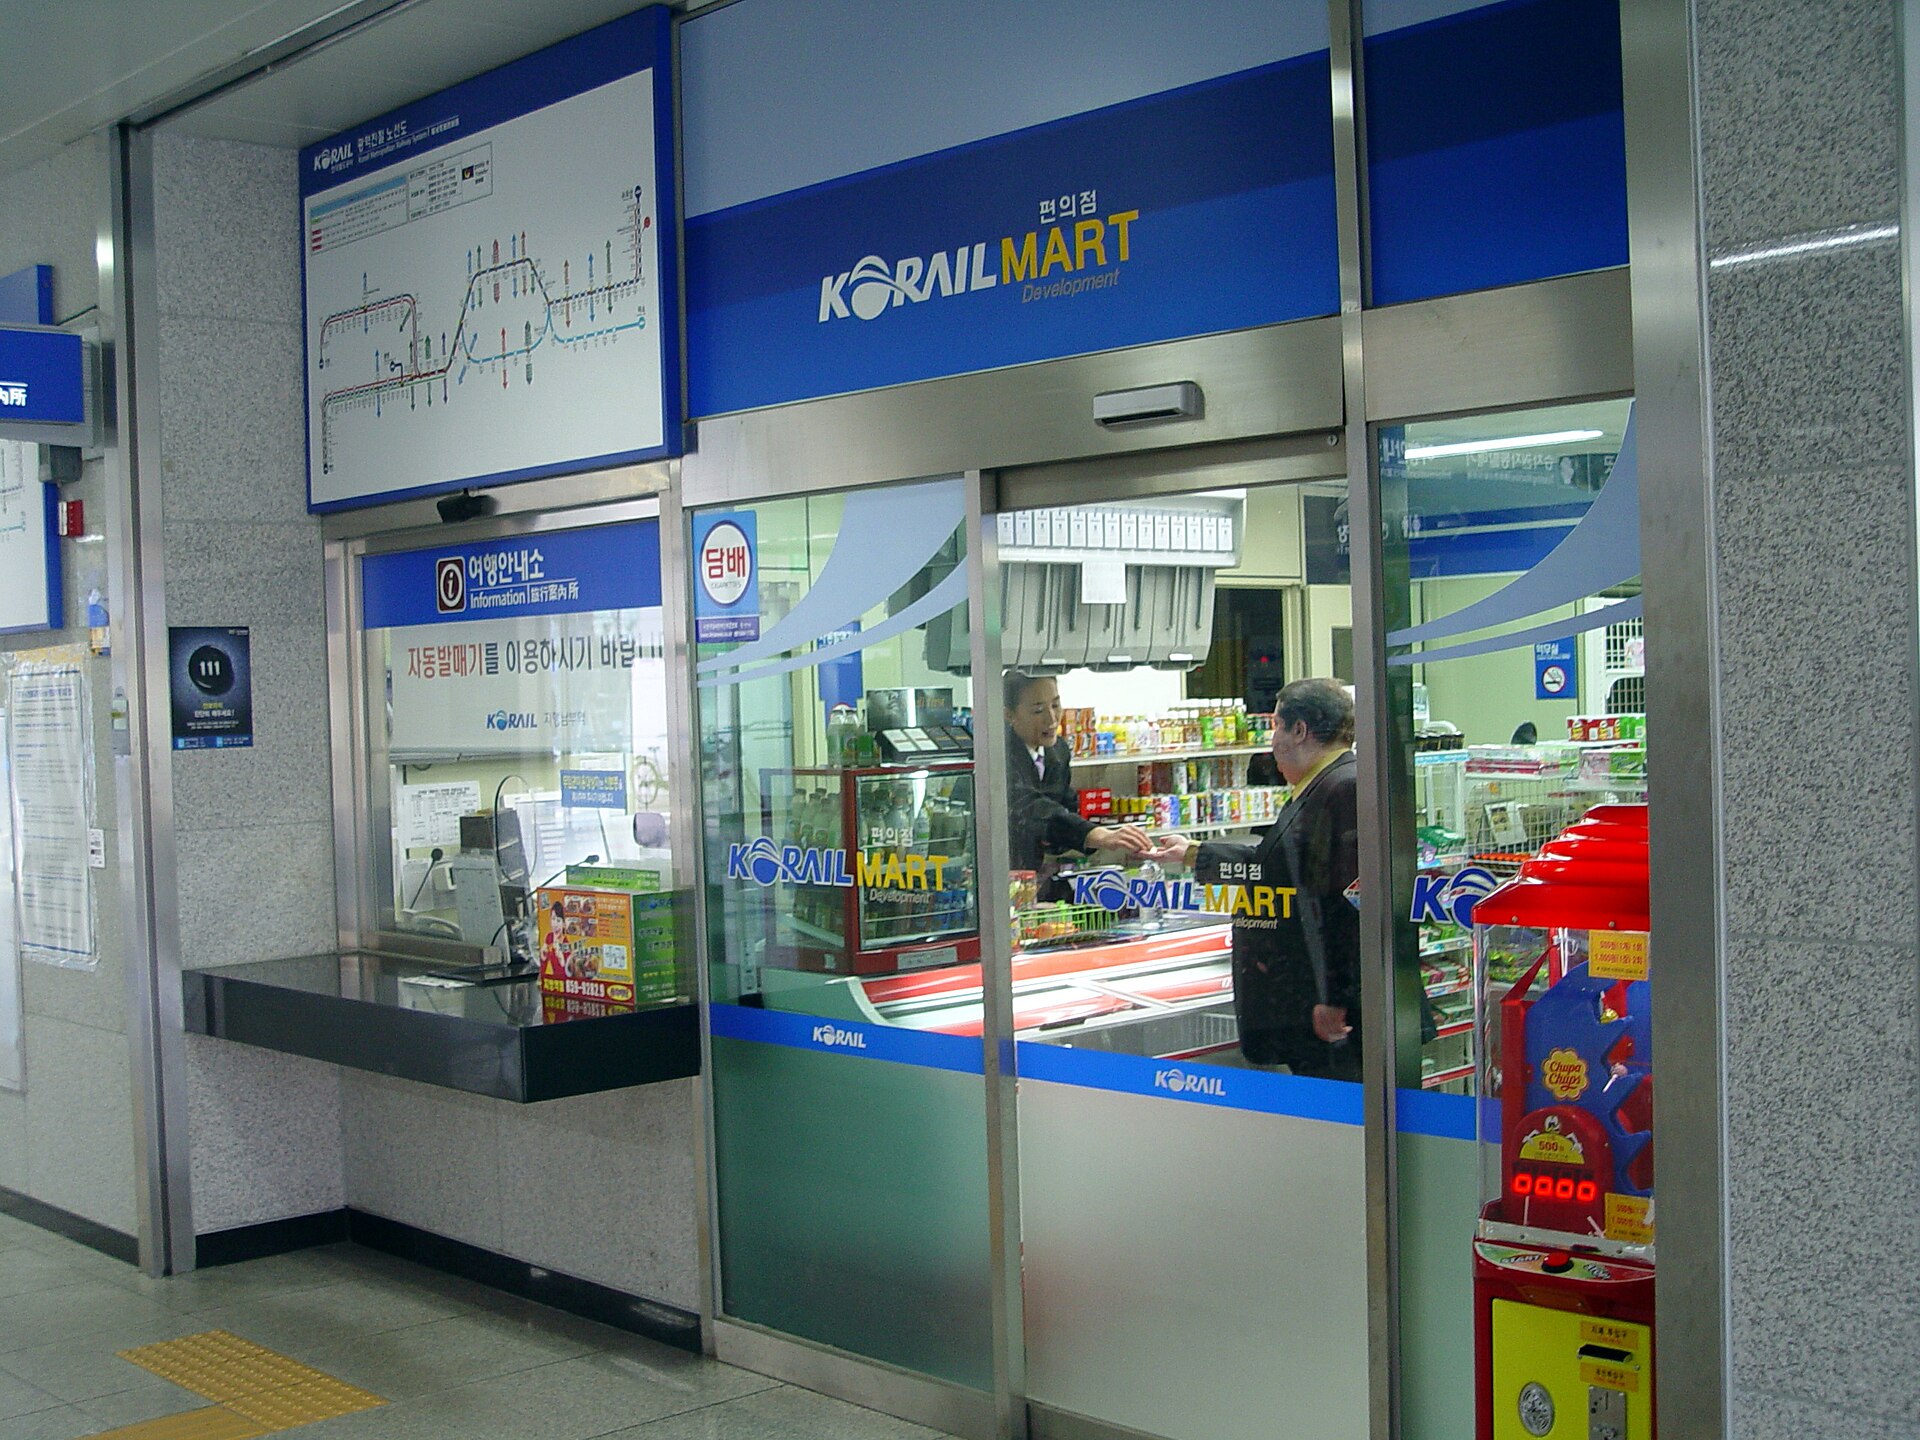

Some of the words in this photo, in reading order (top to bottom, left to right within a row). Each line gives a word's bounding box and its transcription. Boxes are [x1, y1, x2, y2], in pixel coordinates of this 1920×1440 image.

[313, 142, 354, 172] KORAIL
[1039, 189, 1097, 224] 편의점
[818, 242, 997, 324] KORAIL
[1001, 209, 1139, 285] MART
[1021, 267, 1121, 304] Development
[468, 548, 545, 587] 여행안내소
[705, 545, 746, 579] 담배
[470, 588, 526, 609] Information
[200, 661, 220, 676] 111
[408, 642, 499, 679] 자동발매기를
[506, 635, 592, 675] 이용하시기
[486, 709, 538, 731] KORAIL
[870, 826, 913, 847] 편의점
[728, 836, 854, 887] KORAIL
[856, 851, 950, 891] MART
[1218, 861, 1262, 881] 편의점
[869, 889, 934, 905] Development
[1074, 870, 1200, 912] KORAIL
[1204, 883, 1297, 919] MART
[812, 1025, 867, 1048] KORAIL
[1549, 1072, 1581, 1091] Chups
[1550, 1060, 1582, 1075] Chupa
[1154, 1068, 1227, 1096] KORAIL
[1512, 1172, 1598, 1203] 0000
[1500, 1253, 1541, 1265] START
